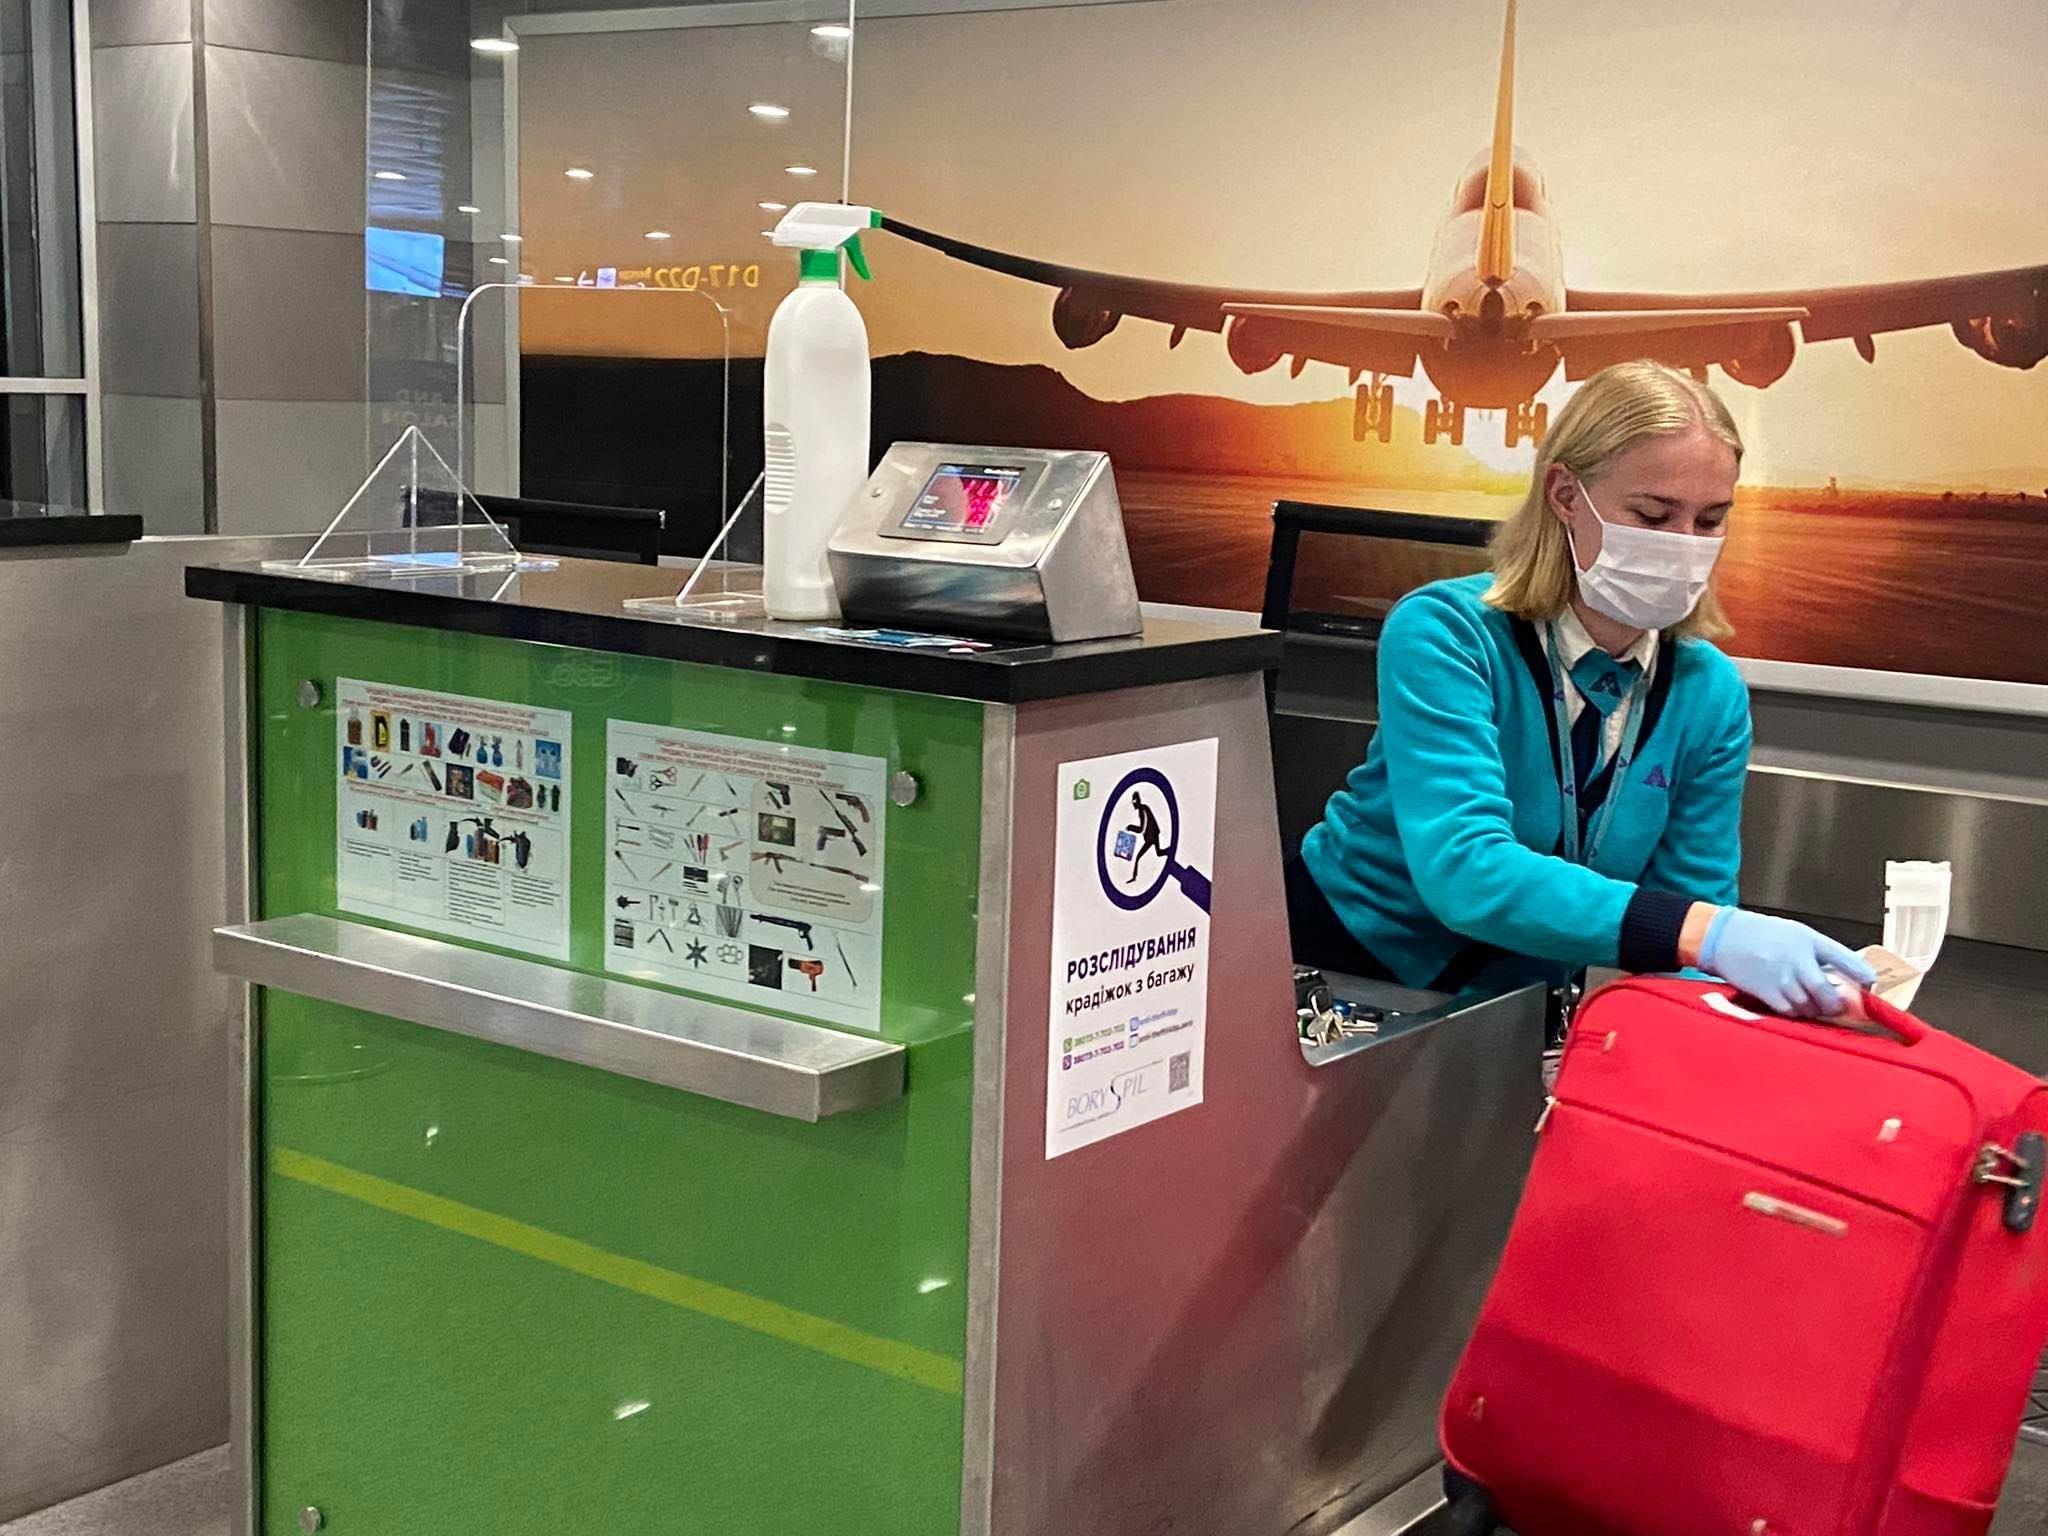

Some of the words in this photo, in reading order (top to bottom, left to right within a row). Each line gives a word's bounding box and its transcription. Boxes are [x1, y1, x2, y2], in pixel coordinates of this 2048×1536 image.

[1067, 927, 1197, 983] РОЗСЛІДУВАННЯ
[1066, 981, 1133, 1015] крадіжок
[1135, 978, 1143, 994] з
[1147, 962, 1195, 990] багажу
